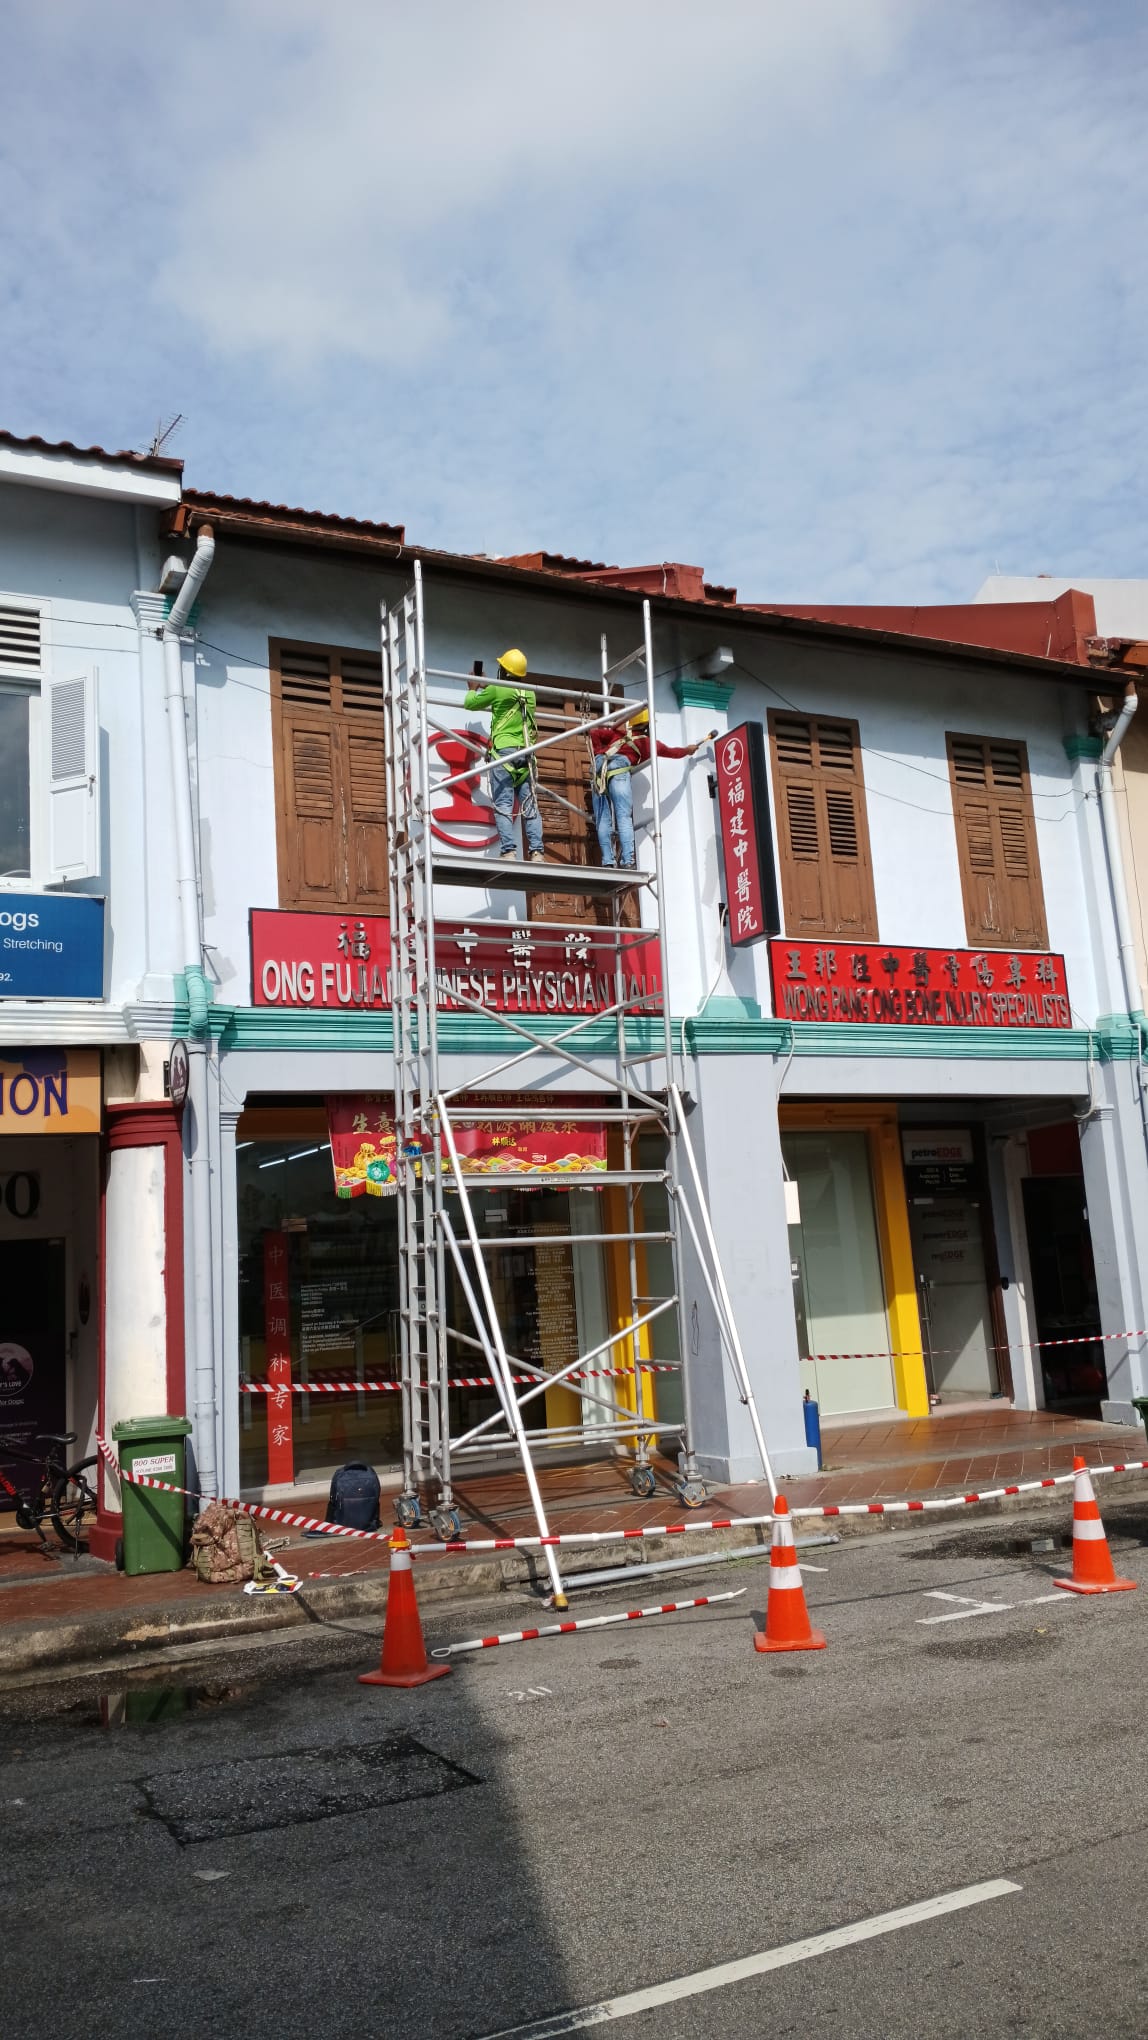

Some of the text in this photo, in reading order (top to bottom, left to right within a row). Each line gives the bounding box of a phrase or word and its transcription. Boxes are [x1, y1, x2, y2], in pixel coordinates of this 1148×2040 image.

[3, 937, 63, 953] Stretching
[337, 922, 595, 969] 福中醫院
[262, 960, 315, 1002] ONG
[502, 969, 609, 1009] PHYSICIAN
[781, 984, 829, 1018] WONG
[831, 986, 869, 1019] PANG
[903, 989, 944, 1022] BONE
[945, 991, 989, 1025] INJURY
[990, 992, 1069, 1025] SPECIALISTS
